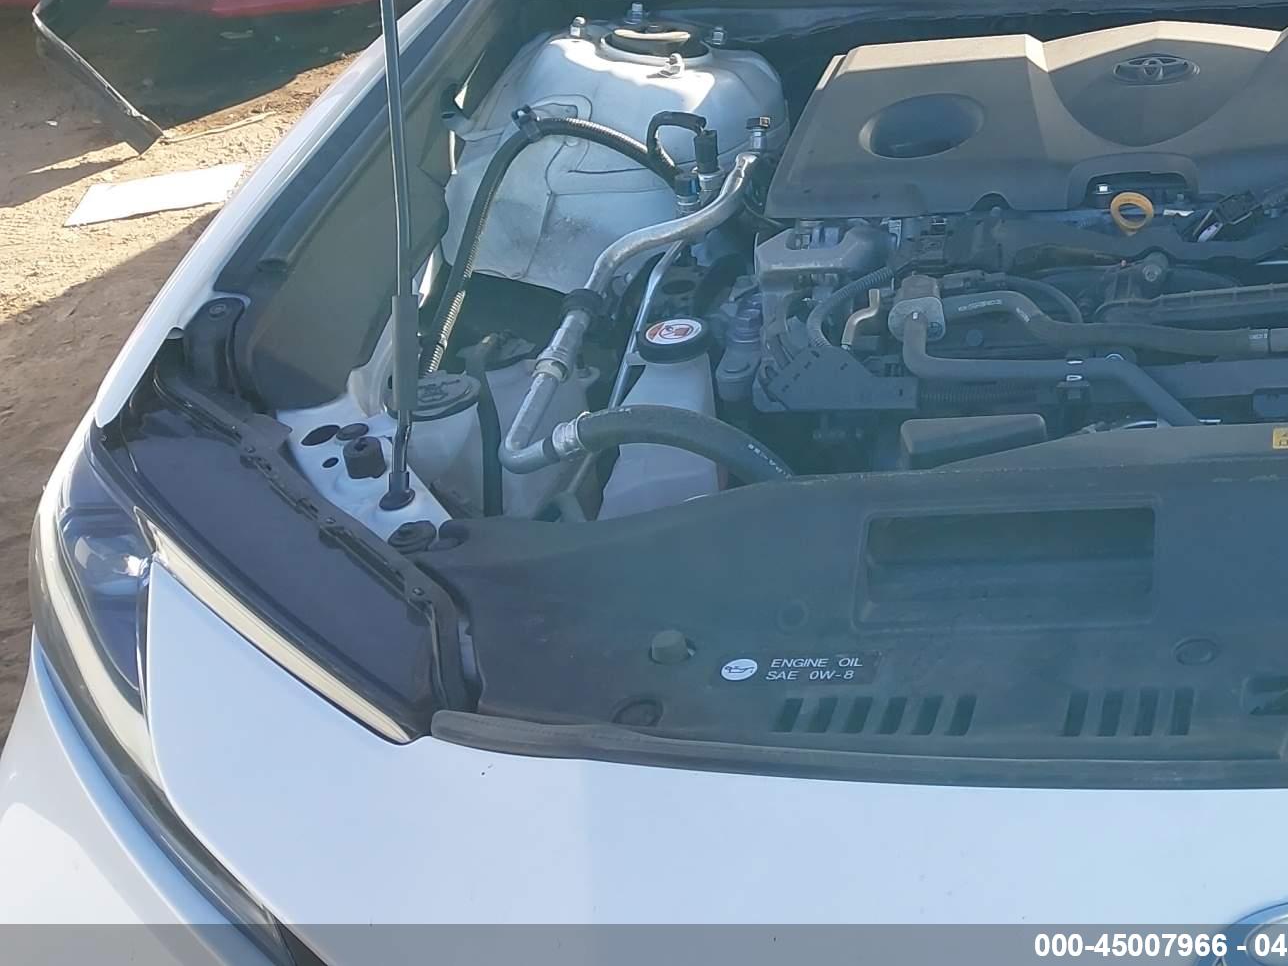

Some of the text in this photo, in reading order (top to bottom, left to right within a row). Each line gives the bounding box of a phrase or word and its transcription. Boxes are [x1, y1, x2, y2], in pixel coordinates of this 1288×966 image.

[771, 657, 863, 668] ENGINE OIL
[766, 669, 855, 681] SAE 0W-8
